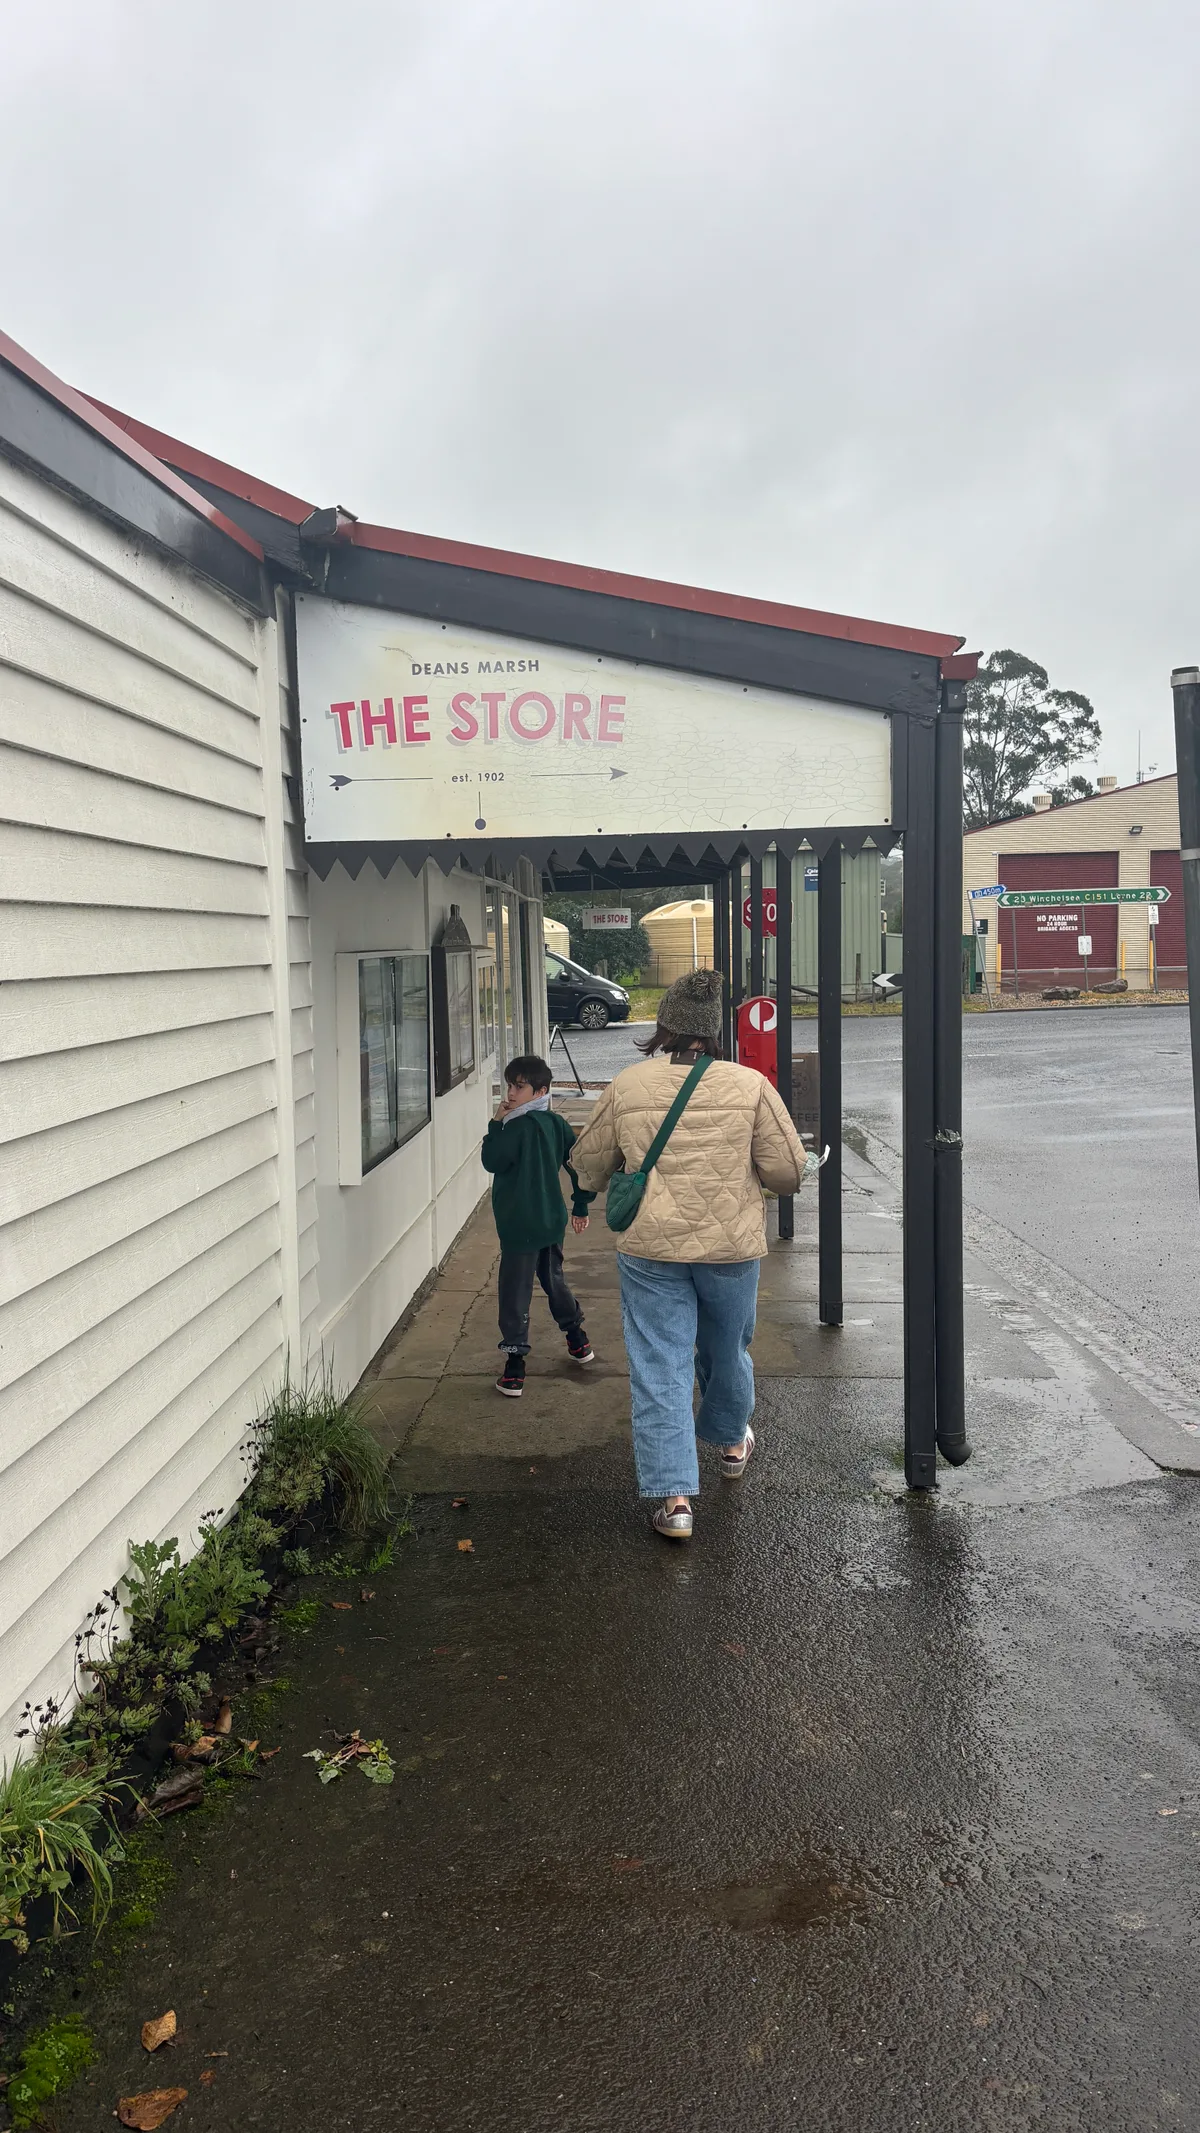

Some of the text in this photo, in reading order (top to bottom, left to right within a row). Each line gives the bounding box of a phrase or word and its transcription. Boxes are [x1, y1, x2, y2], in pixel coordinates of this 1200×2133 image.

[411, 659, 540, 676] DEANS MARSH
[326, 690, 627, 754] THE STORE
[452, 772, 505, 783] est. 1902
[1014, 895, 1026, 904] 23
[1029, 894, 1080, 903] Winchelsea
[1084, 893, 1106, 901] C151
[1110, 892, 1136, 900] Lorne
[593, 914, 628, 924] THE STORE
